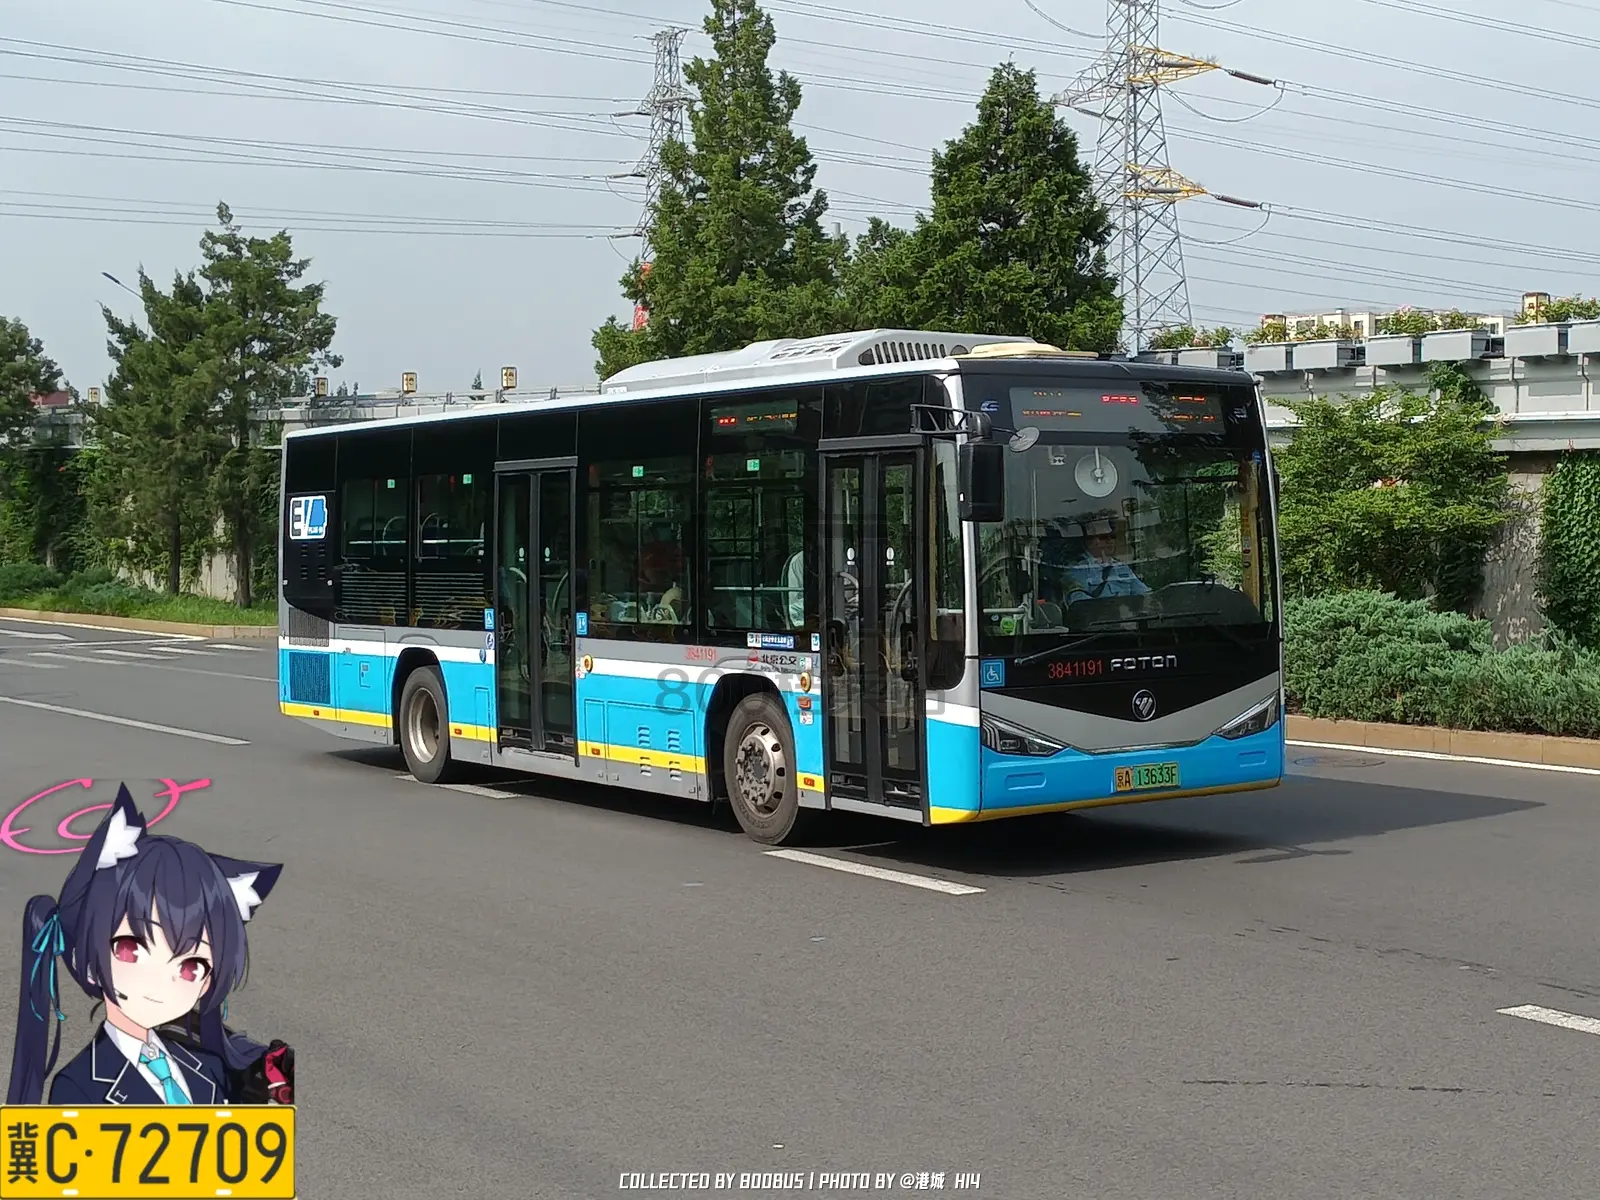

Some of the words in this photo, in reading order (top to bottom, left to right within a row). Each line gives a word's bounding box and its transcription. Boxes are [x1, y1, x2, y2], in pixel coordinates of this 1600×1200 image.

[762, 653, 797, 666] 北京公交
[1048, 659, 1103, 679] 3841191
